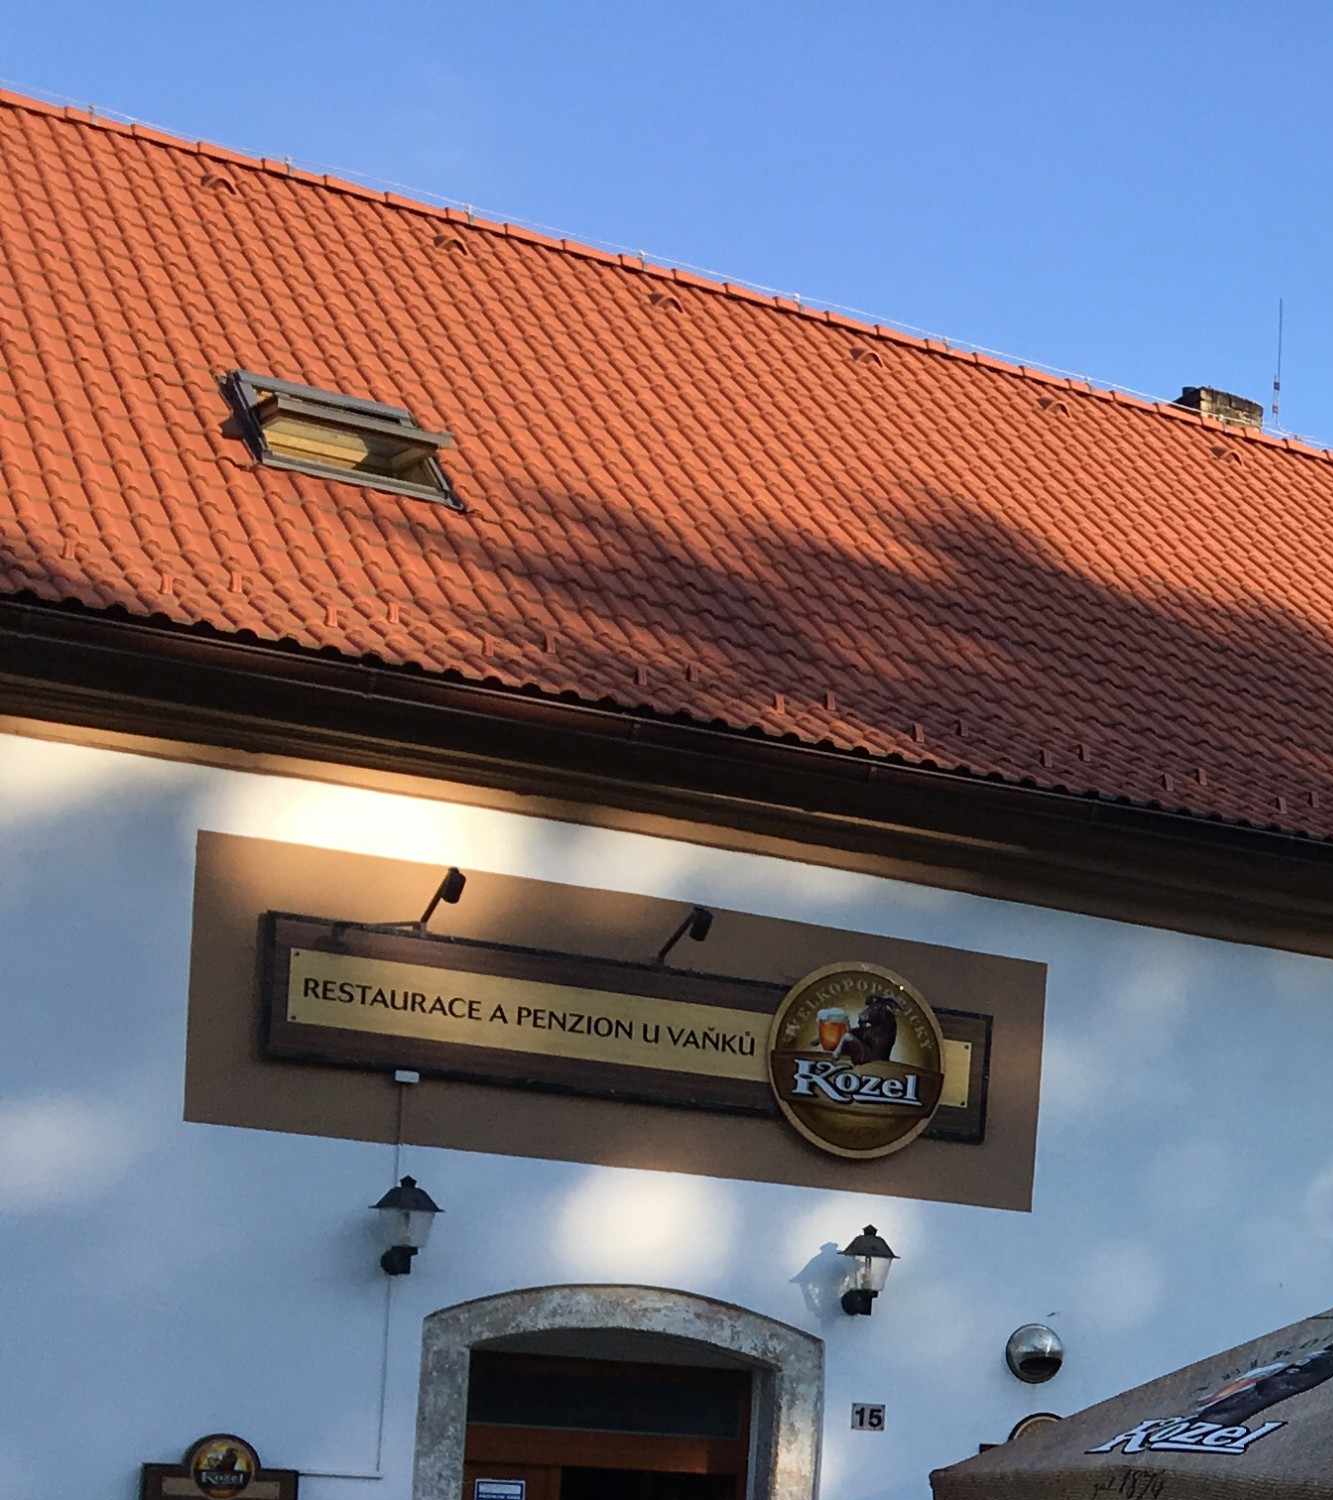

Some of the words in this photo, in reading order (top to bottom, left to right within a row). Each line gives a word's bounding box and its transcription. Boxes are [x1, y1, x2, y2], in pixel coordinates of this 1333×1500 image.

[303, 977, 482, 1021] RESTAURACE
[488, 1003, 509, 1025] A
[516, 1006, 633, 1040] PENZION
[641, 1022, 661, 1044] U
[667, 1026, 756, 1057] VAŇKŮ
[791, 1058, 923, 1107] Kozel
[855, 1406, 883, 1428] 15
[1084, 1415, 1289, 1455] Kozel
